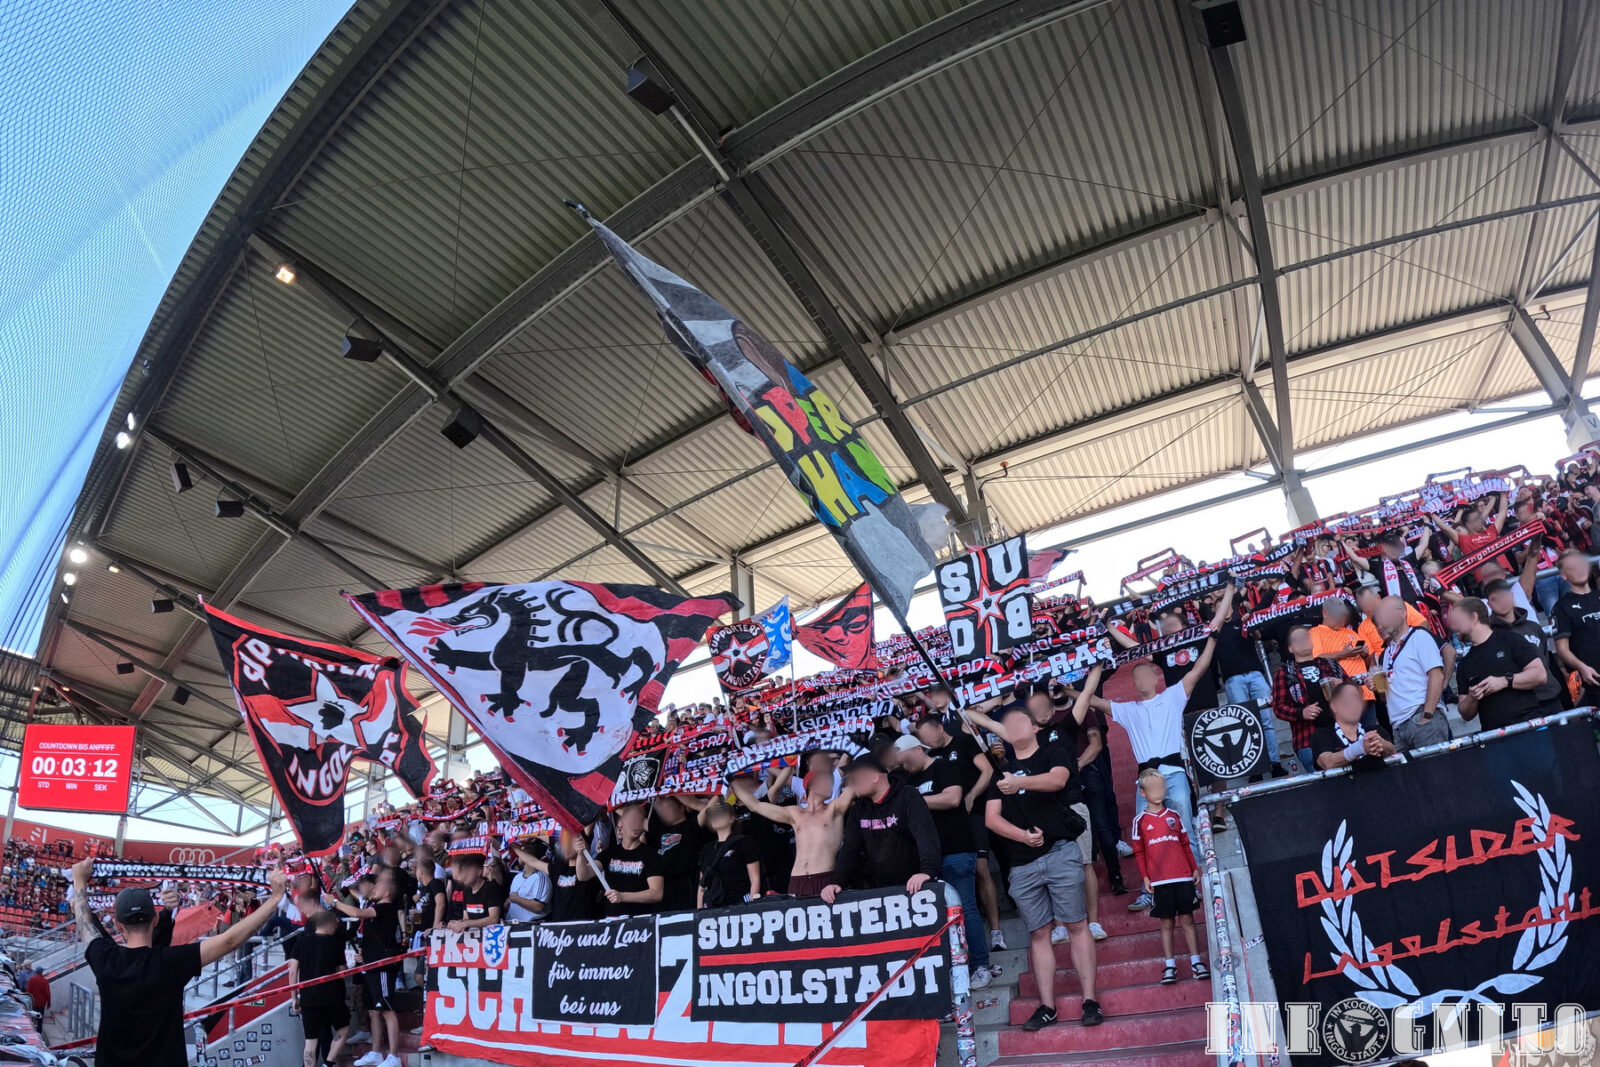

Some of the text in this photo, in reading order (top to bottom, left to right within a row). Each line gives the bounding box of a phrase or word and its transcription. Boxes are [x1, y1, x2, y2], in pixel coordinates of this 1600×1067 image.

[710, 624, 760, 655] SUPPORTERS
[722, 654, 767, 687] INGOLSTADT
[1202, 707, 1255, 726] KOGNITO
[39, 742, 78, 750] COUNTDOWN
[1199, 743, 1260, 775] INGOLSTADT
[184, 865, 270, 884] INGOLSTA
[698, 889, 938, 950] SUPPORTERS
[428, 929, 481, 965] FKS
[536, 923, 652, 956] Mofo und Lars
[548, 960, 633, 988] für immer
[698, 954, 943, 1007] INGOLSTADT
[560, 994, 621, 1016] bei uns
